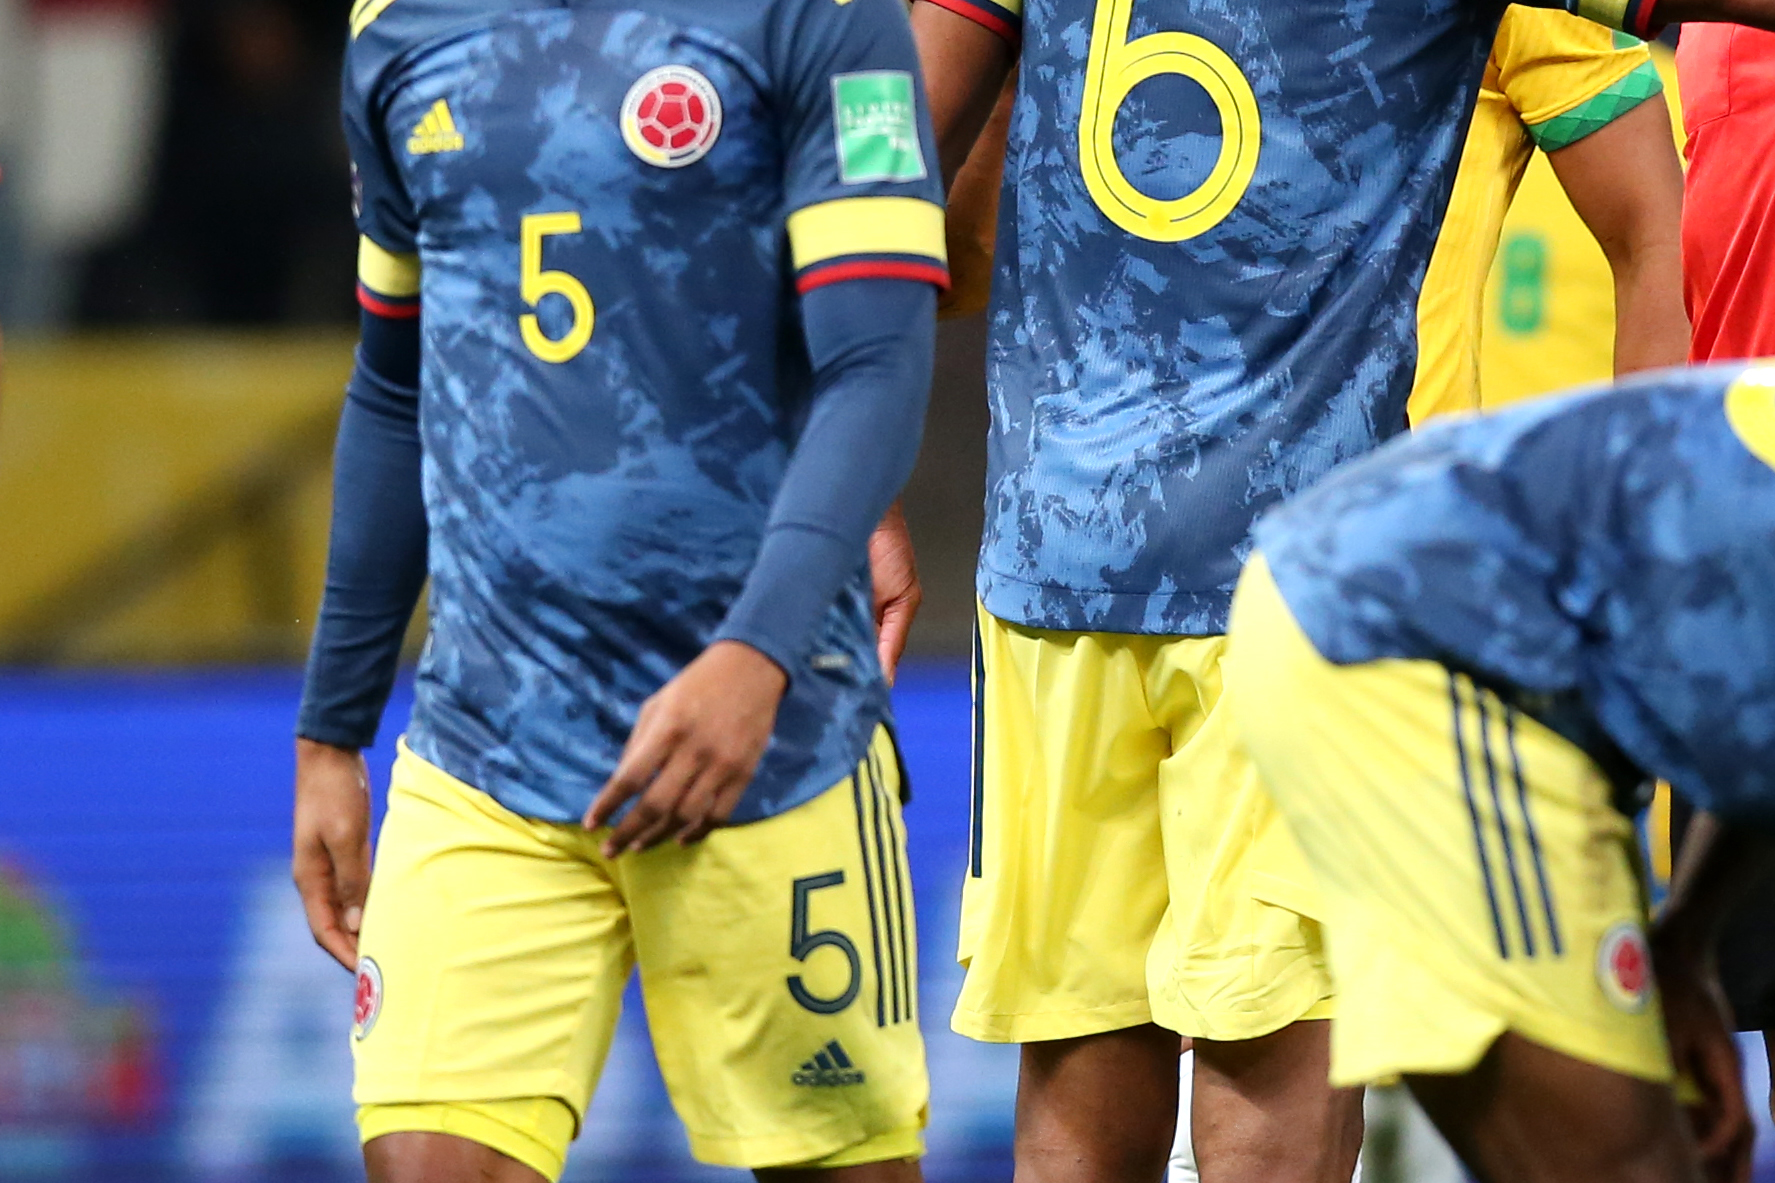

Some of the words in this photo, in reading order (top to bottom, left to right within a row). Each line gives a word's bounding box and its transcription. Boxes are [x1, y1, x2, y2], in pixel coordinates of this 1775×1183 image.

[519, 211, 595, 364] 5
[1501, 235, 1545, 333] 8
[787, 870, 861, 1015] 5
